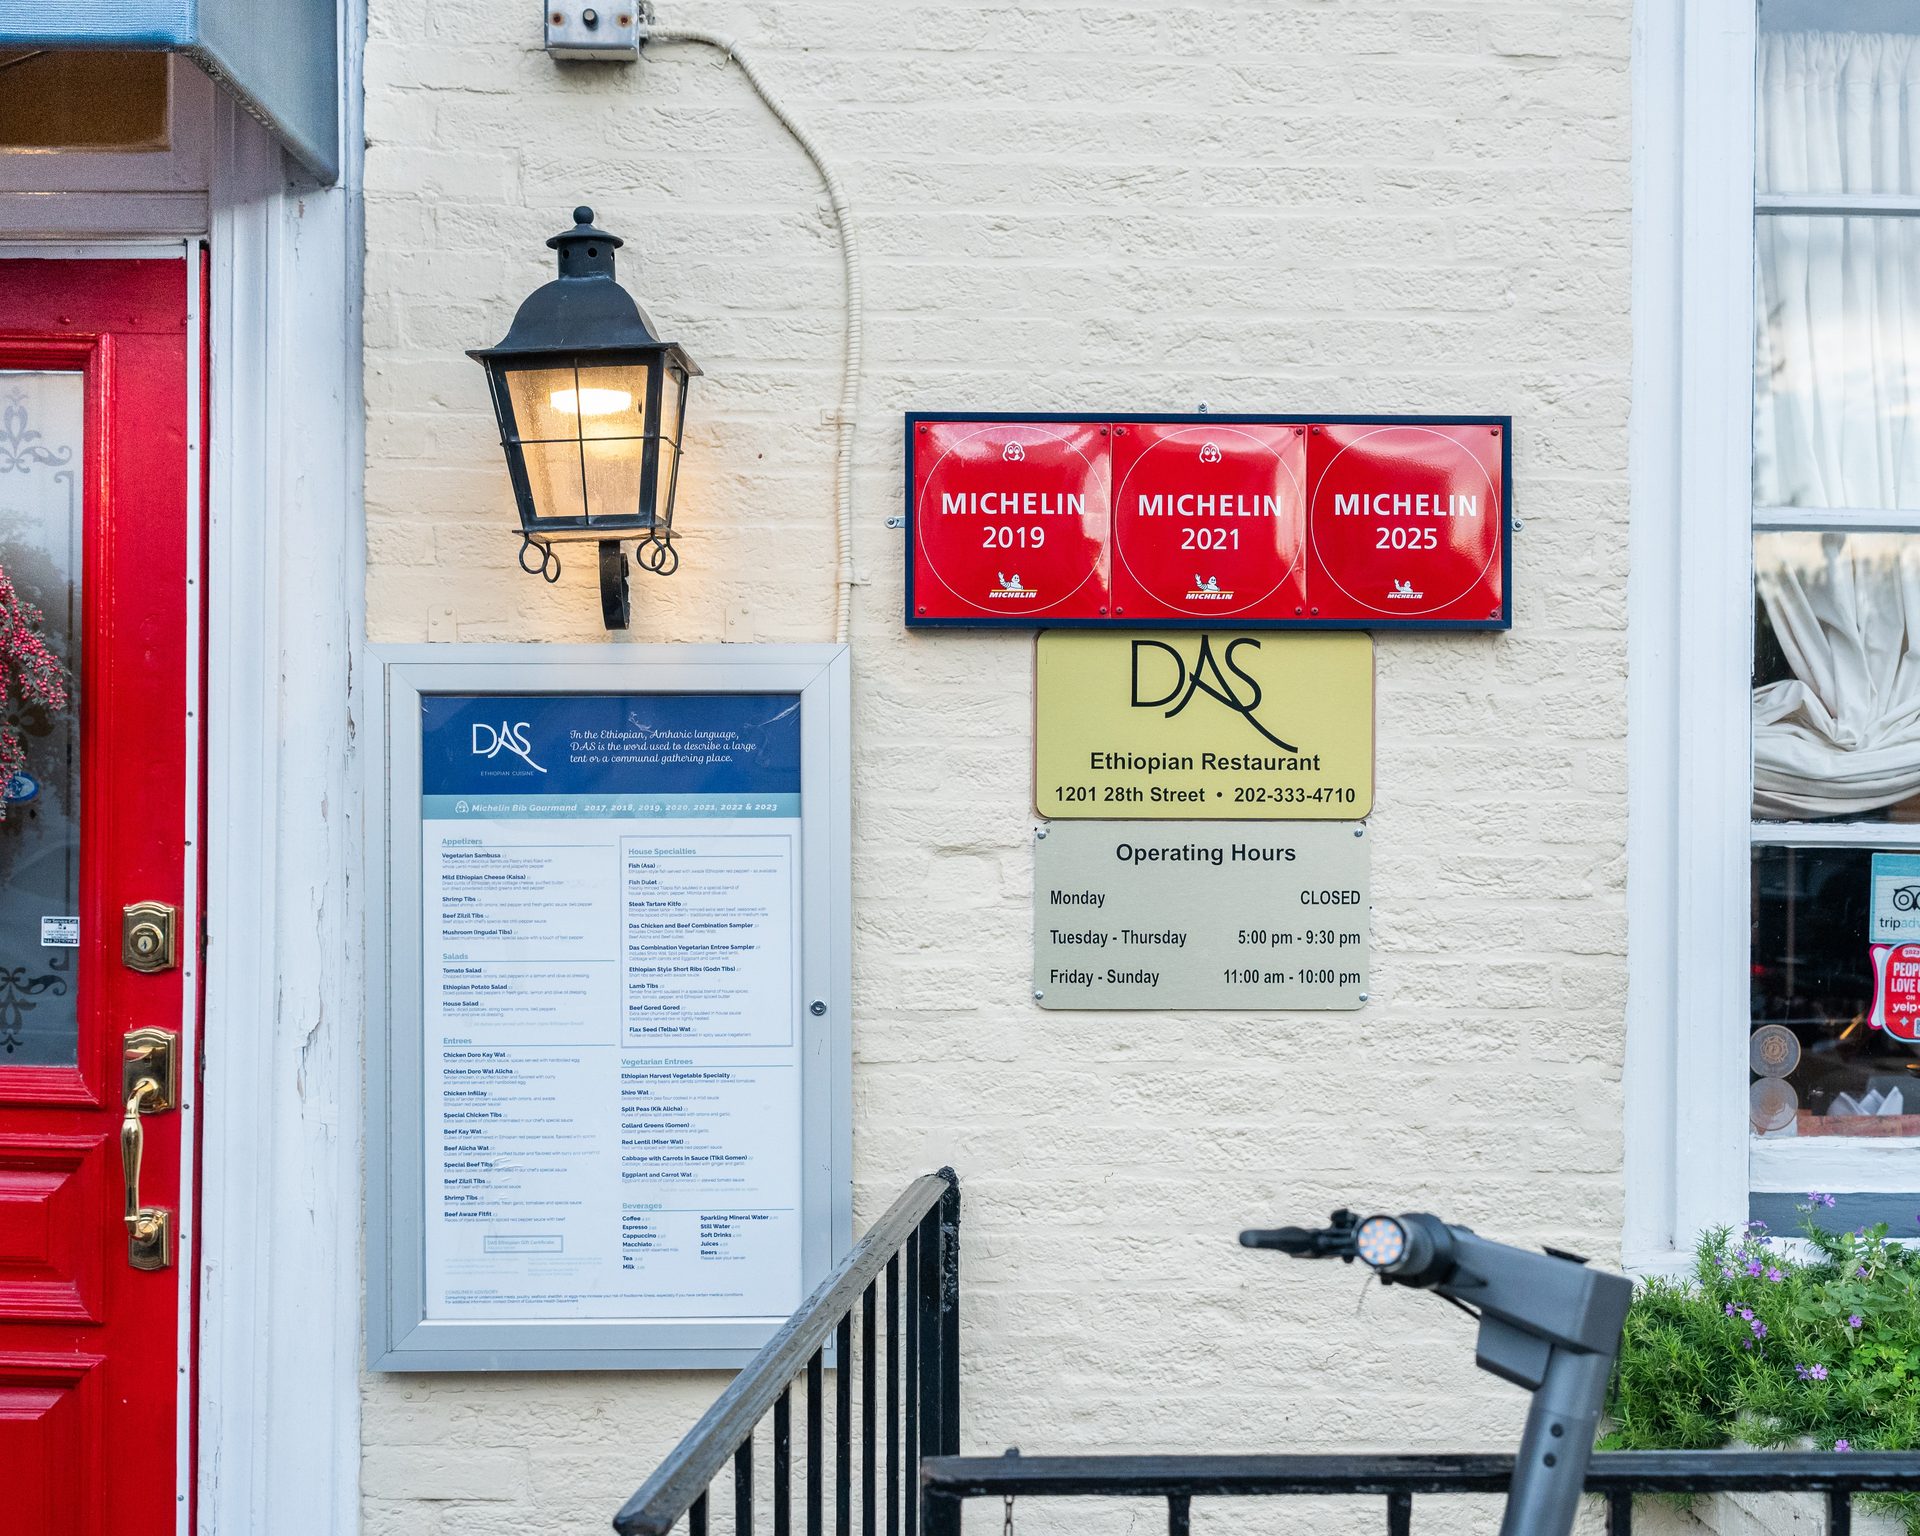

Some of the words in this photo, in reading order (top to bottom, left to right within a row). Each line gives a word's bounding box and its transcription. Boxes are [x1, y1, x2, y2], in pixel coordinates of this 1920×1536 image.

[942, 492, 1086, 516] MICHELIN
[1138, 494, 1282, 518] MICHELIN
[1334, 493, 1477, 517] MICHELIN
[982, 526, 1046, 549] 2019
[1180, 528, 1241, 551] 2021
[1375, 528, 1438, 550] 2025
[988, 591, 1037, 599] MICHELIN
[1185, 592, 1234, 600] MICHELIN
[1131, 634, 1298, 754] DAS
[569, 729, 583, 740] In
[584, 730, 599, 739] the
[600, 730, 648, 741] Ethiopian,
[649, 730, 693, 739] Amharic
[694, 729, 739, 741] language,
[472, 720, 548, 773] DAS
[569, 742, 596, 751] DAS
[597, 742, 606, 751] is
[607, 742, 622, 750] the
[623, 742, 649, 750] word
[649, 742, 671, 750] used
[684, 741, 721, 750] describe
[732, 741, 756, 752] large
[570, 754, 588, 763] tent
[611, 753, 660, 763] communal
[661, 753, 704, 765] gathering
[706, 753, 733, 765] place.
[1090, 752, 1193, 774] Ethiopian
[1202, 752, 1321, 771] Restaurant
[1055, 787, 1097, 802] 1201
[1104, 787, 1144, 802] 28th
[1150, 787, 1205, 802] Street
[1234, 787, 1356, 803] 202-333-4710
[529, 804, 577, 812] Gourmand
[611, 804, 636, 812] 2018,
[638, 804, 663, 812] 2019,
[754, 803, 778, 812] 2023
[441, 837, 483, 846] Appetizers
[654, 848, 697, 856] Specialties
[1116, 843, 1224, 865] Operating
[1231, 843, 1296, 862] Hours
[1050, 891, 1105, 908] Monday
[1300, 890, 1361, 905] CLOSED
[1050, 930, 1108, 947] Tuesday
[1121, 929, 1187, 948] Thursday
[1238, 930, 1267, 945] 5:00
[1271, 933, 1293, 948] pm
[1306, 930, 1334, 945] 9:30
[1338, 933, 1361, 948] pm
[1050, 969, 1094, 987] Friday
[1106, 969, 1160, 987] Sunday
[1224, 969, 1260, 984] 11:00
[1263, 972, 1285, 984] am
[1298, 969, 1334, 984] 10:00
[1338, 972, 1361, 987] pm
[1891, 978, 1916, 993] LOVE
[1892, 1002, 1917, 1014] yelp
[621, 1058, 663, 1066] Vegetarian
[622, 1202, 663, 1210] Beverages
